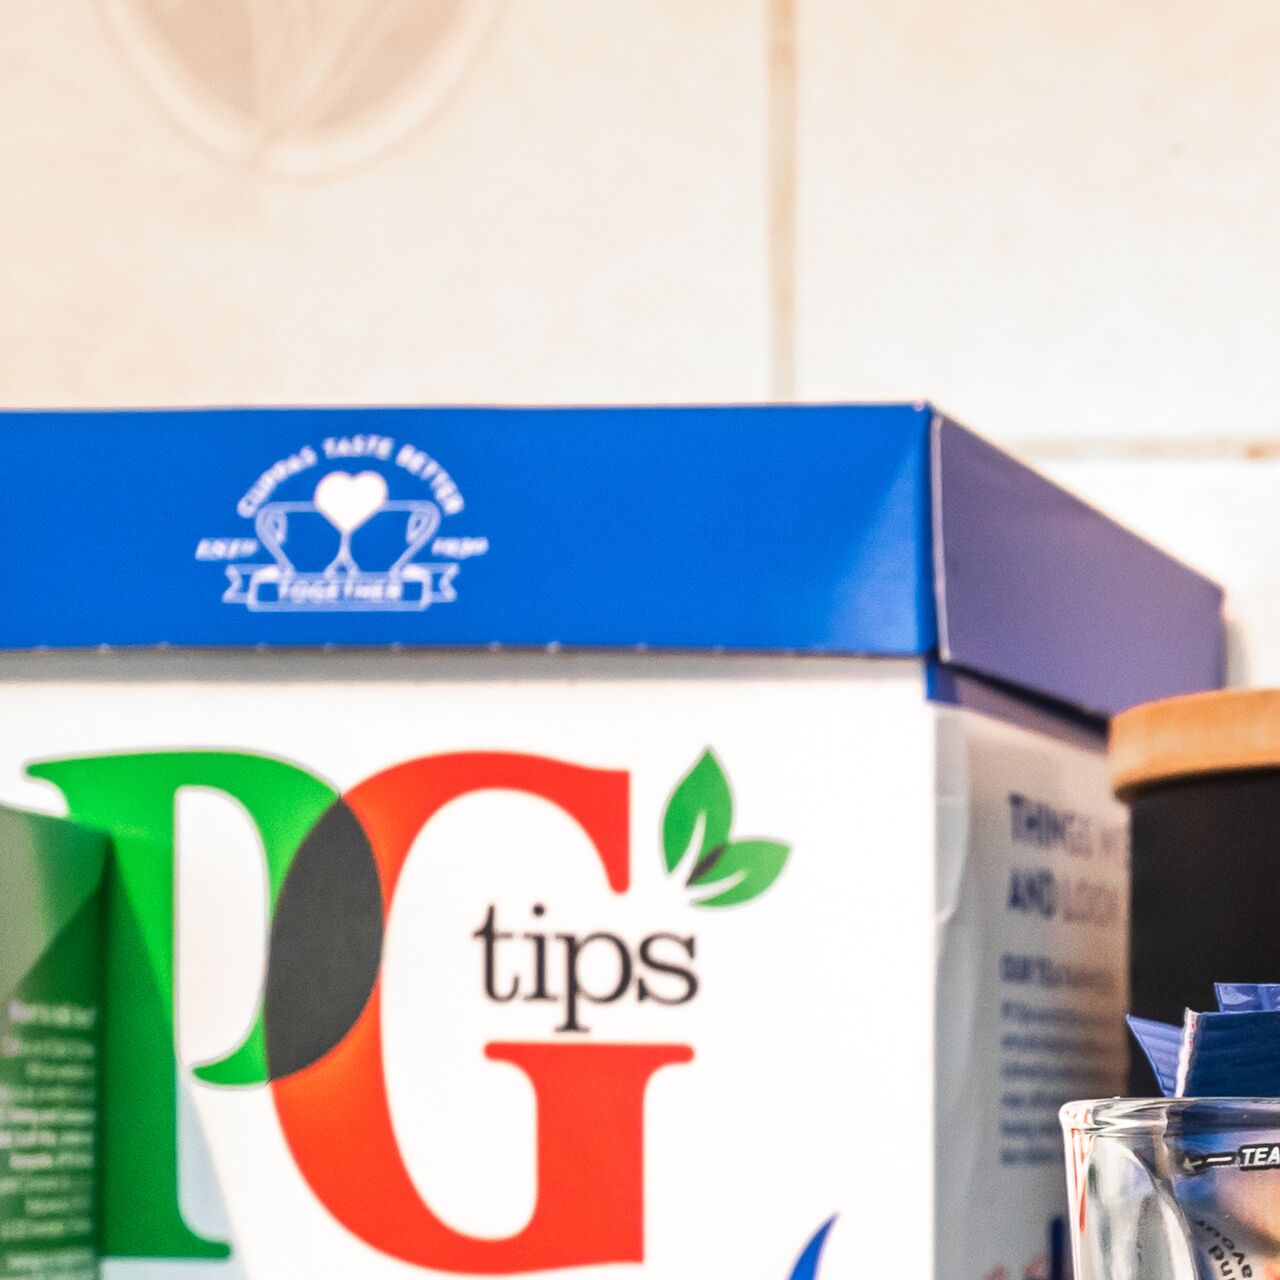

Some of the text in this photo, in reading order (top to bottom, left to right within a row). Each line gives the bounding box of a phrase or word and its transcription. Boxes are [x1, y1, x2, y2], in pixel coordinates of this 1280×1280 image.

[322, 434, 394, 459] TASTE
[396, 444, 464, 515] BETTER
[22, 748, 695, 1278] PG
[472, 902, 700, 1034] tips
